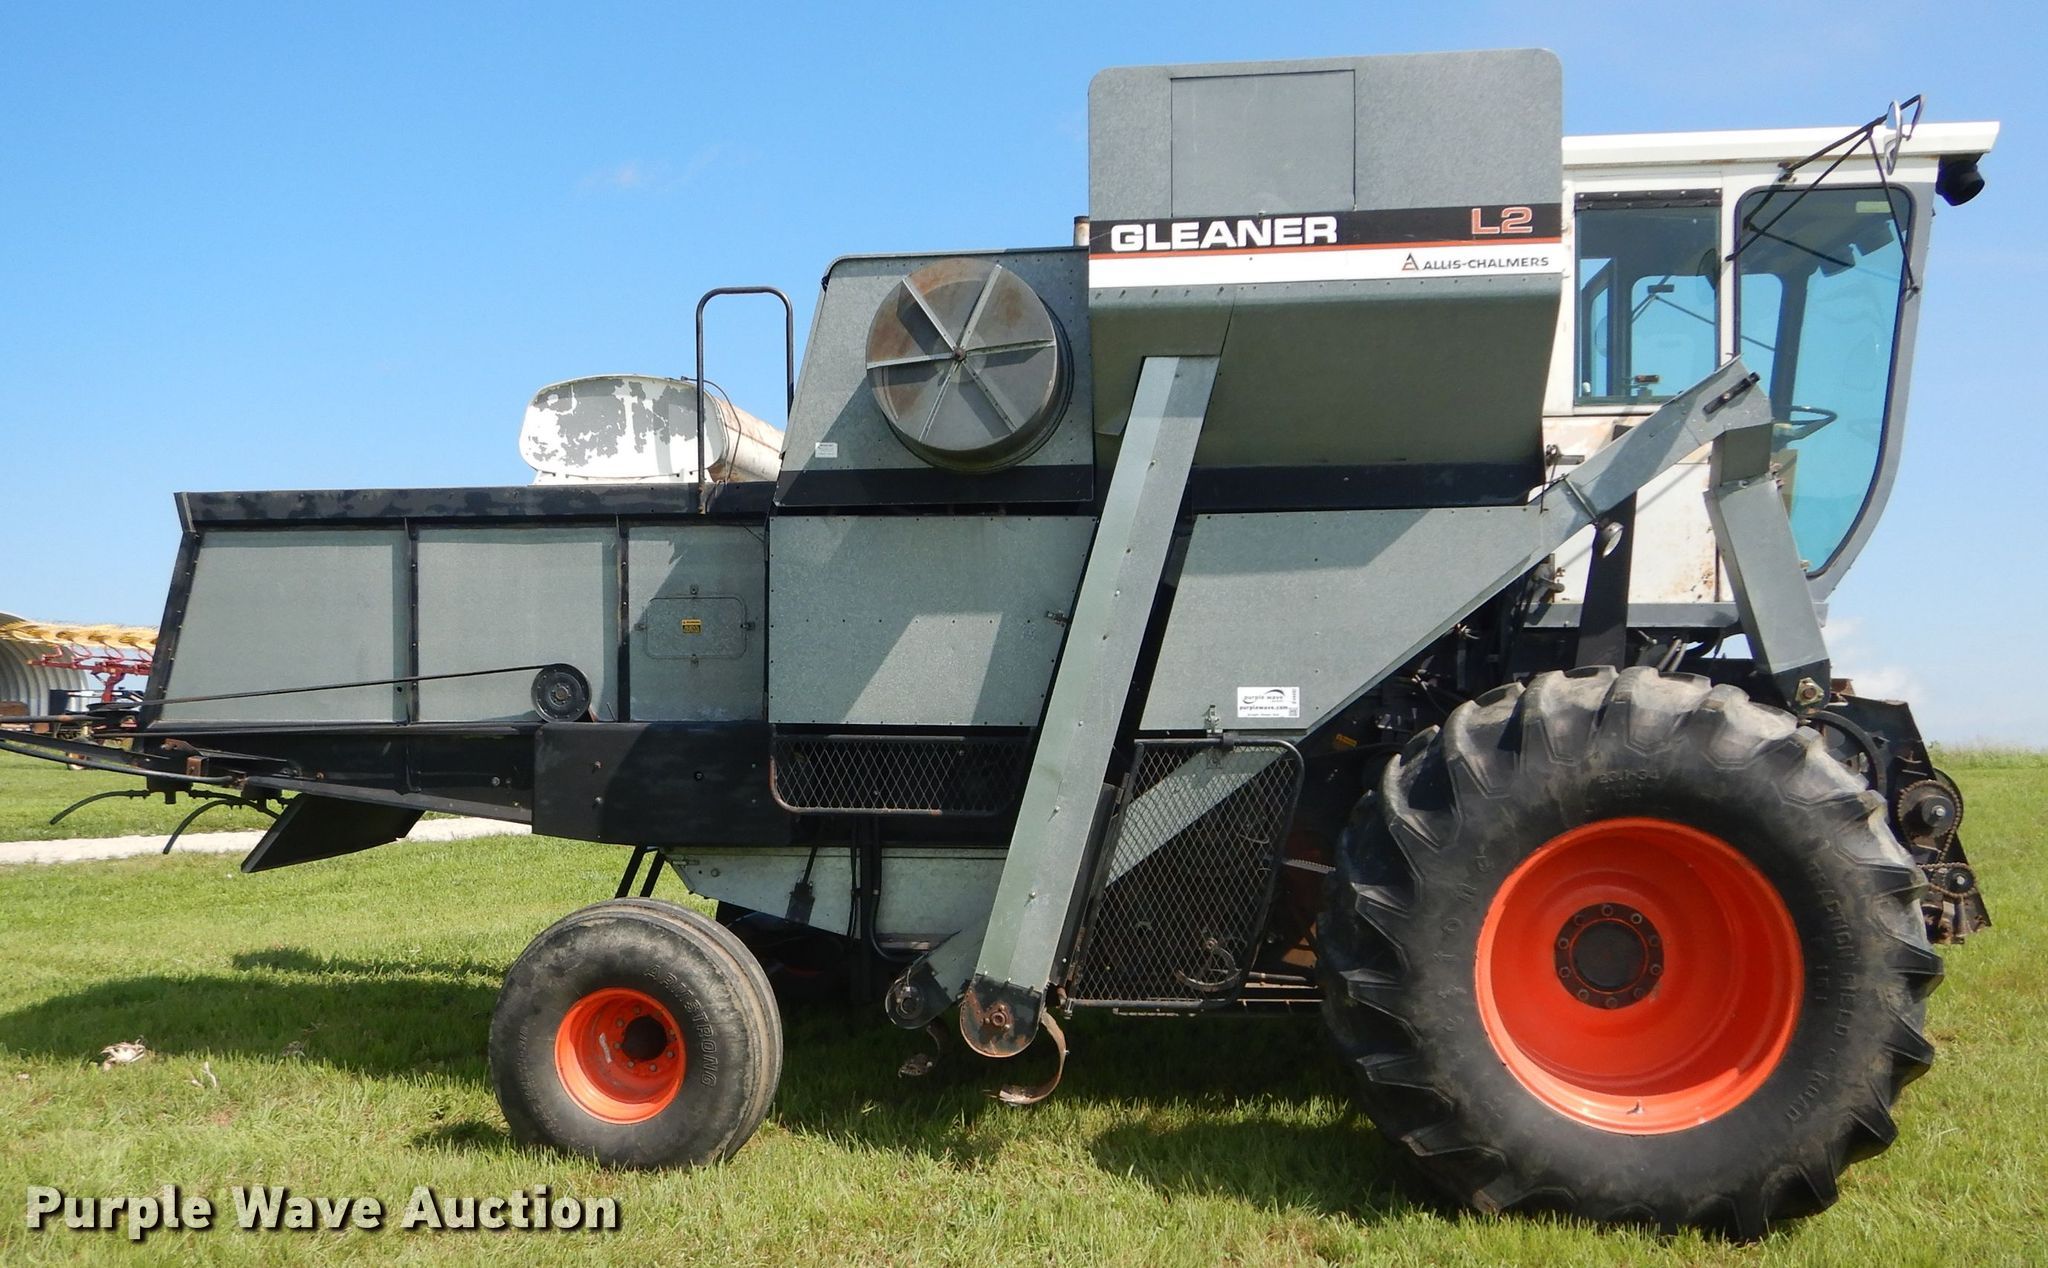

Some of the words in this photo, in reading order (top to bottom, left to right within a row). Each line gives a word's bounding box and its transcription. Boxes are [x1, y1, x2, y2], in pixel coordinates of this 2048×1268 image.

[1110, 215, 1337, 252] GLEANER
[1470, 206, 1533, 235] L2
[1423, 256, 1549, 271] ALLIS-CHALMERS
